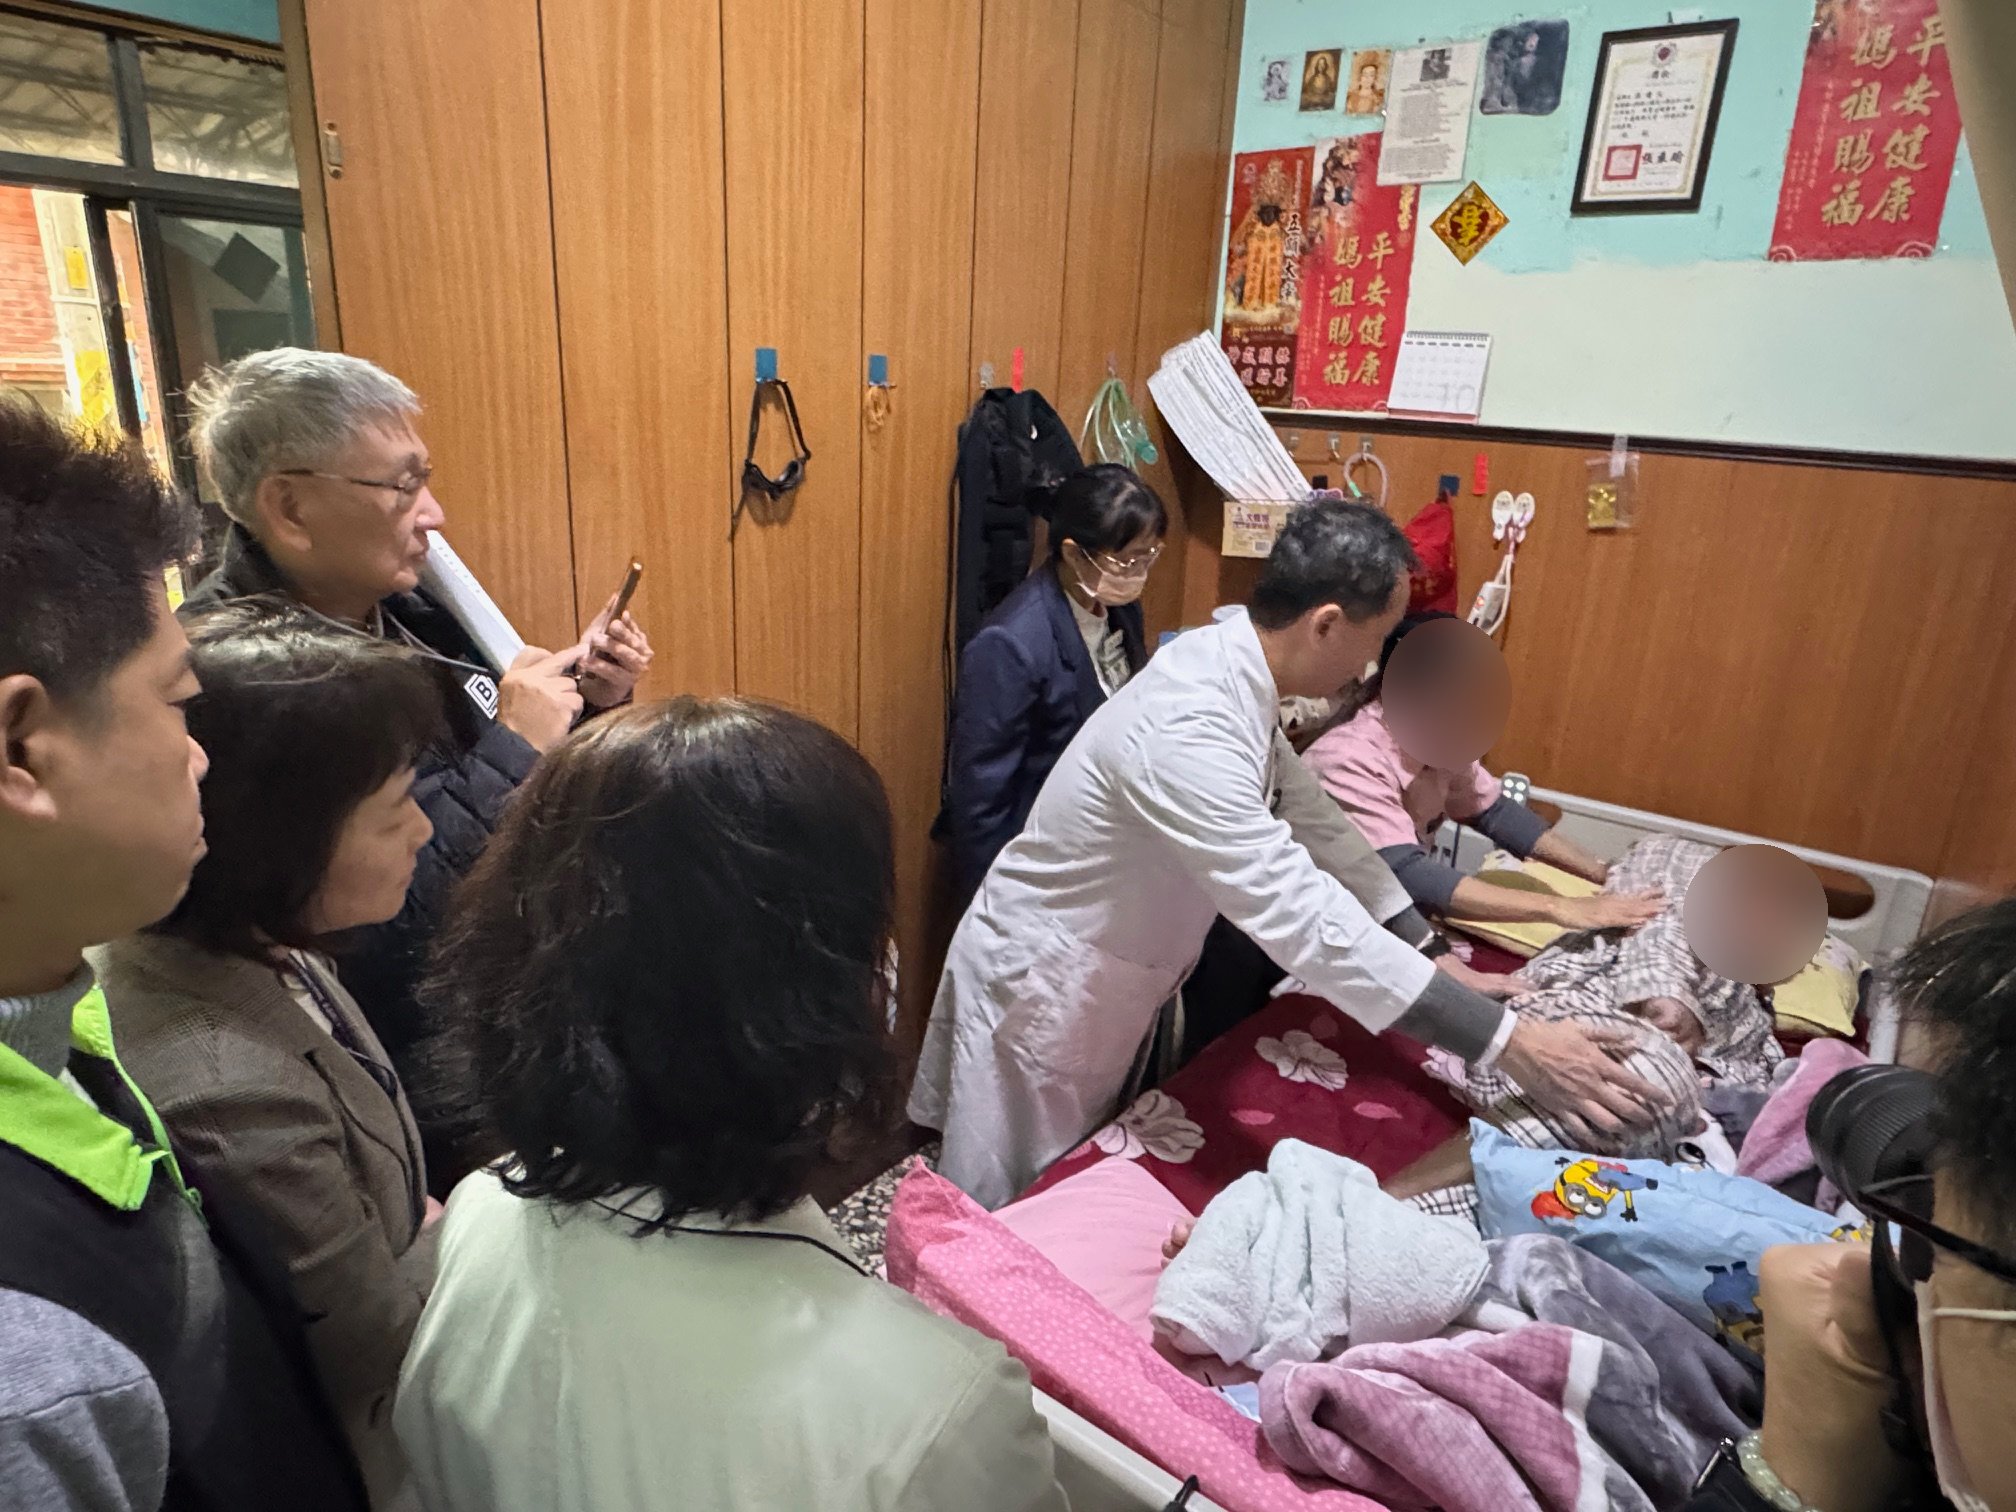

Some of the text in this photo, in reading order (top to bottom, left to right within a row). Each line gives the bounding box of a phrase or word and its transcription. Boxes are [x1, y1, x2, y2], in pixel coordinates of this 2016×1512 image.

[1821, 24, 1898, 227] 媽祖賜福
[1867, 16, 1946, 223] 平安健康
[1323, 235, 1363, 386] 媽祖賜福
[1352, 231, 1395, 386] 平安健康
[476, 682, 492, 702] B
